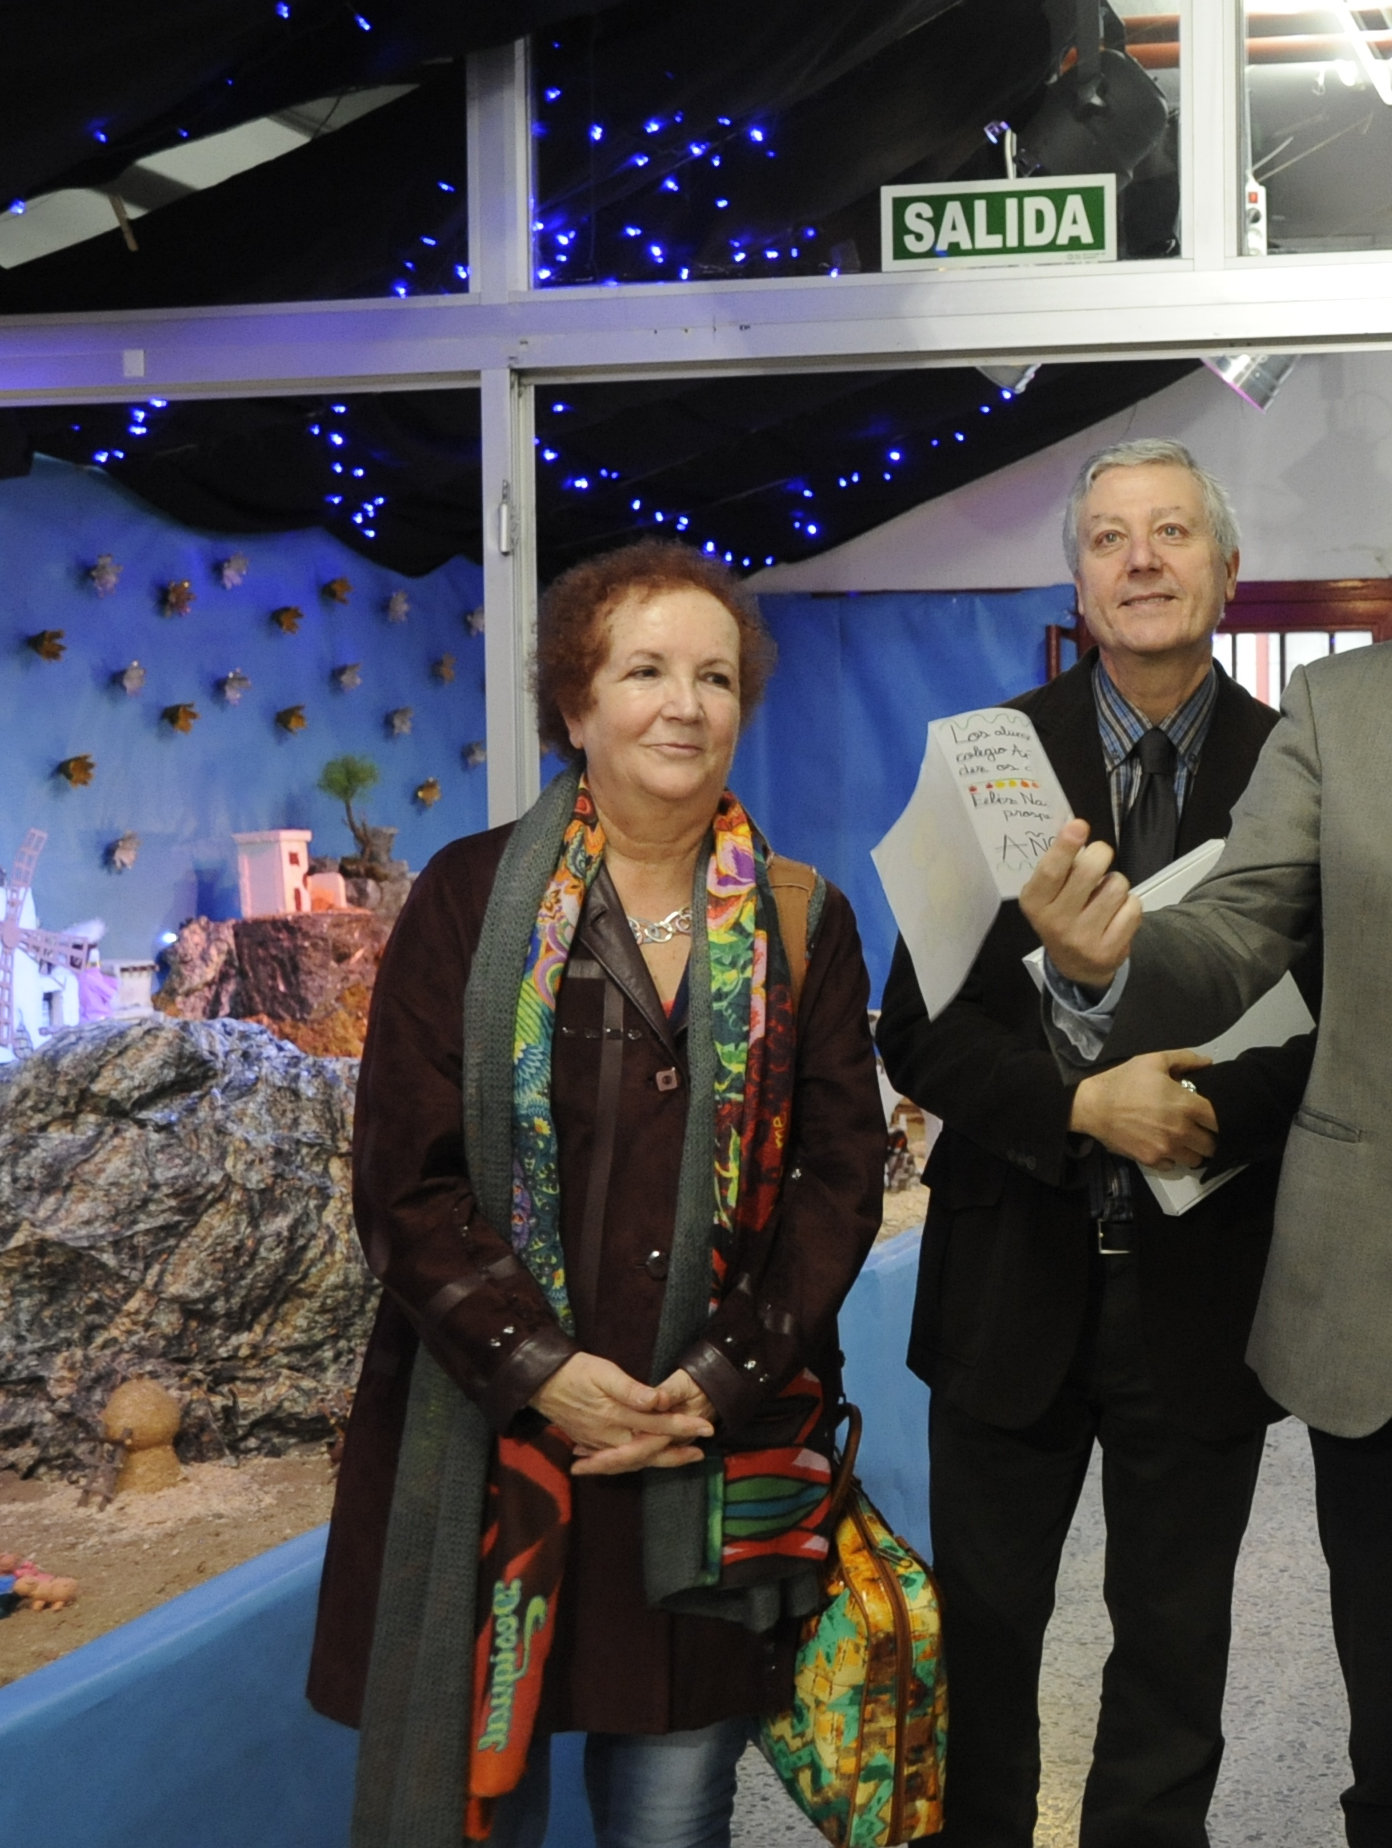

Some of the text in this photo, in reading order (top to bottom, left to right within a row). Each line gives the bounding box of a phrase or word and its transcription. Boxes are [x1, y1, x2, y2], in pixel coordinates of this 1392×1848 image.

[903, 194, 1094, 253] SALIDA
[950, 724, 991, 744] Los
[956, 745, 1008, 762] colegio
[971, 791, 1018, 808] Feliz
